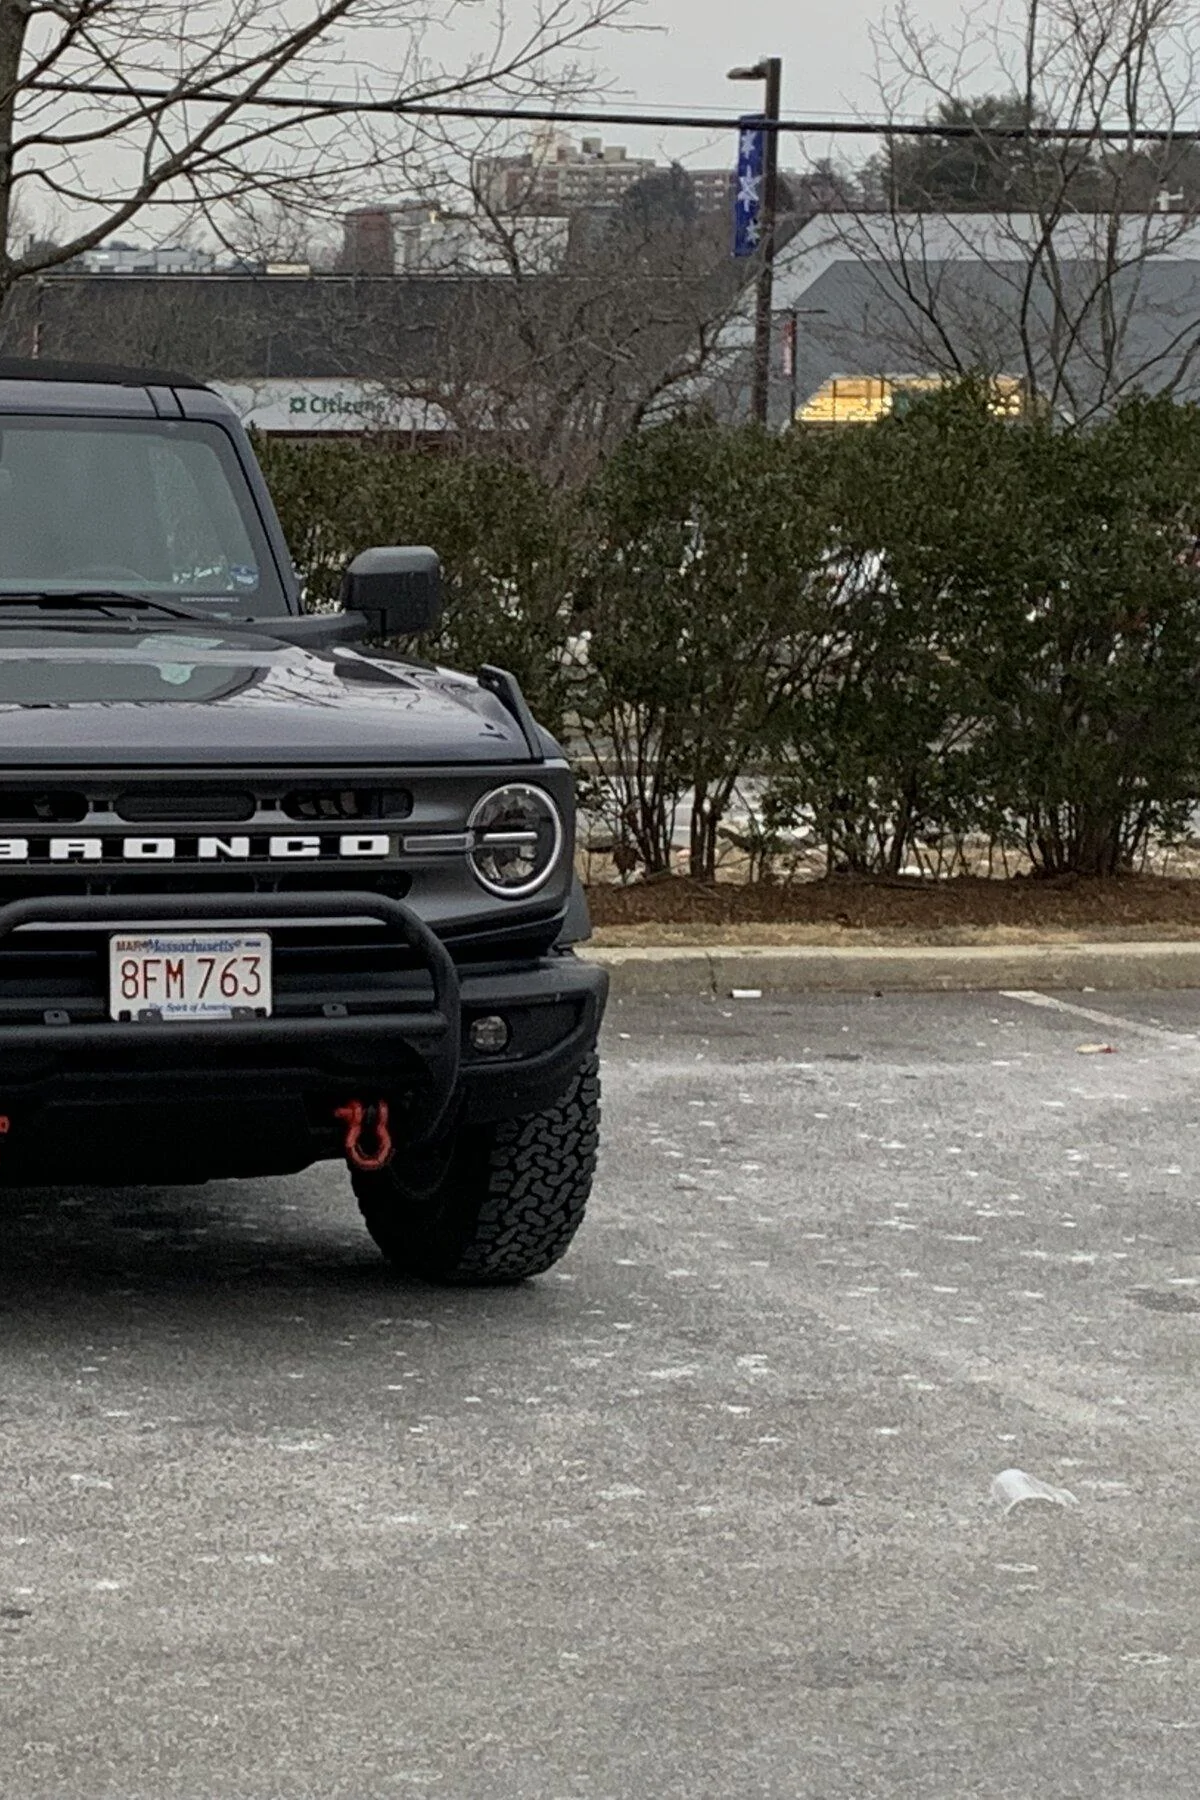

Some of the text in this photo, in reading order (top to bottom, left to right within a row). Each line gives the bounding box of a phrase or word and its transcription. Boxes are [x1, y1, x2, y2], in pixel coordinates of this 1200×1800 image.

[310, 394, 386, 415] Citizens
[148, 938, 234, 953] Massachusetts
[120, 955, 261, 999] 8FM 763
[166, 1002, 188, 1012] Spirit
